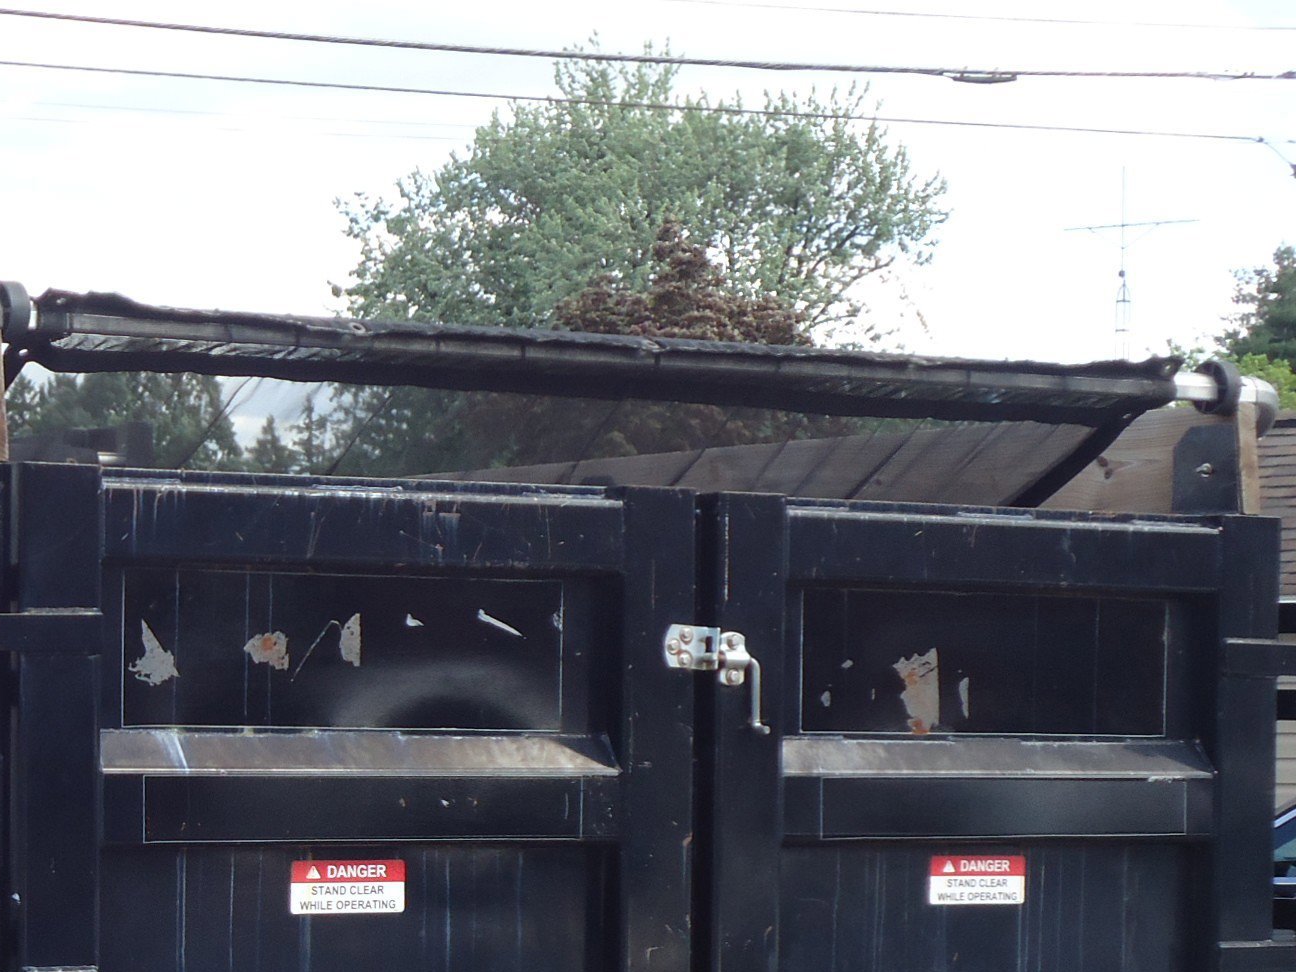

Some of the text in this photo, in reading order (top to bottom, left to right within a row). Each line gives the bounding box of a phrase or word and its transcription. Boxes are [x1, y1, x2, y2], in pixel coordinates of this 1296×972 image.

[960, 859, 1011, 872] DANGER
[327, 864, 387, 879] DANGER
[947, 878, 1008, 888] STAND CLEAR
[311, 885, 385, 895] STAND CLEAR
[937, 891, 1018, 901] WHILE OPERATING
[299, 899, 396, 911] WHILE OPERATING
